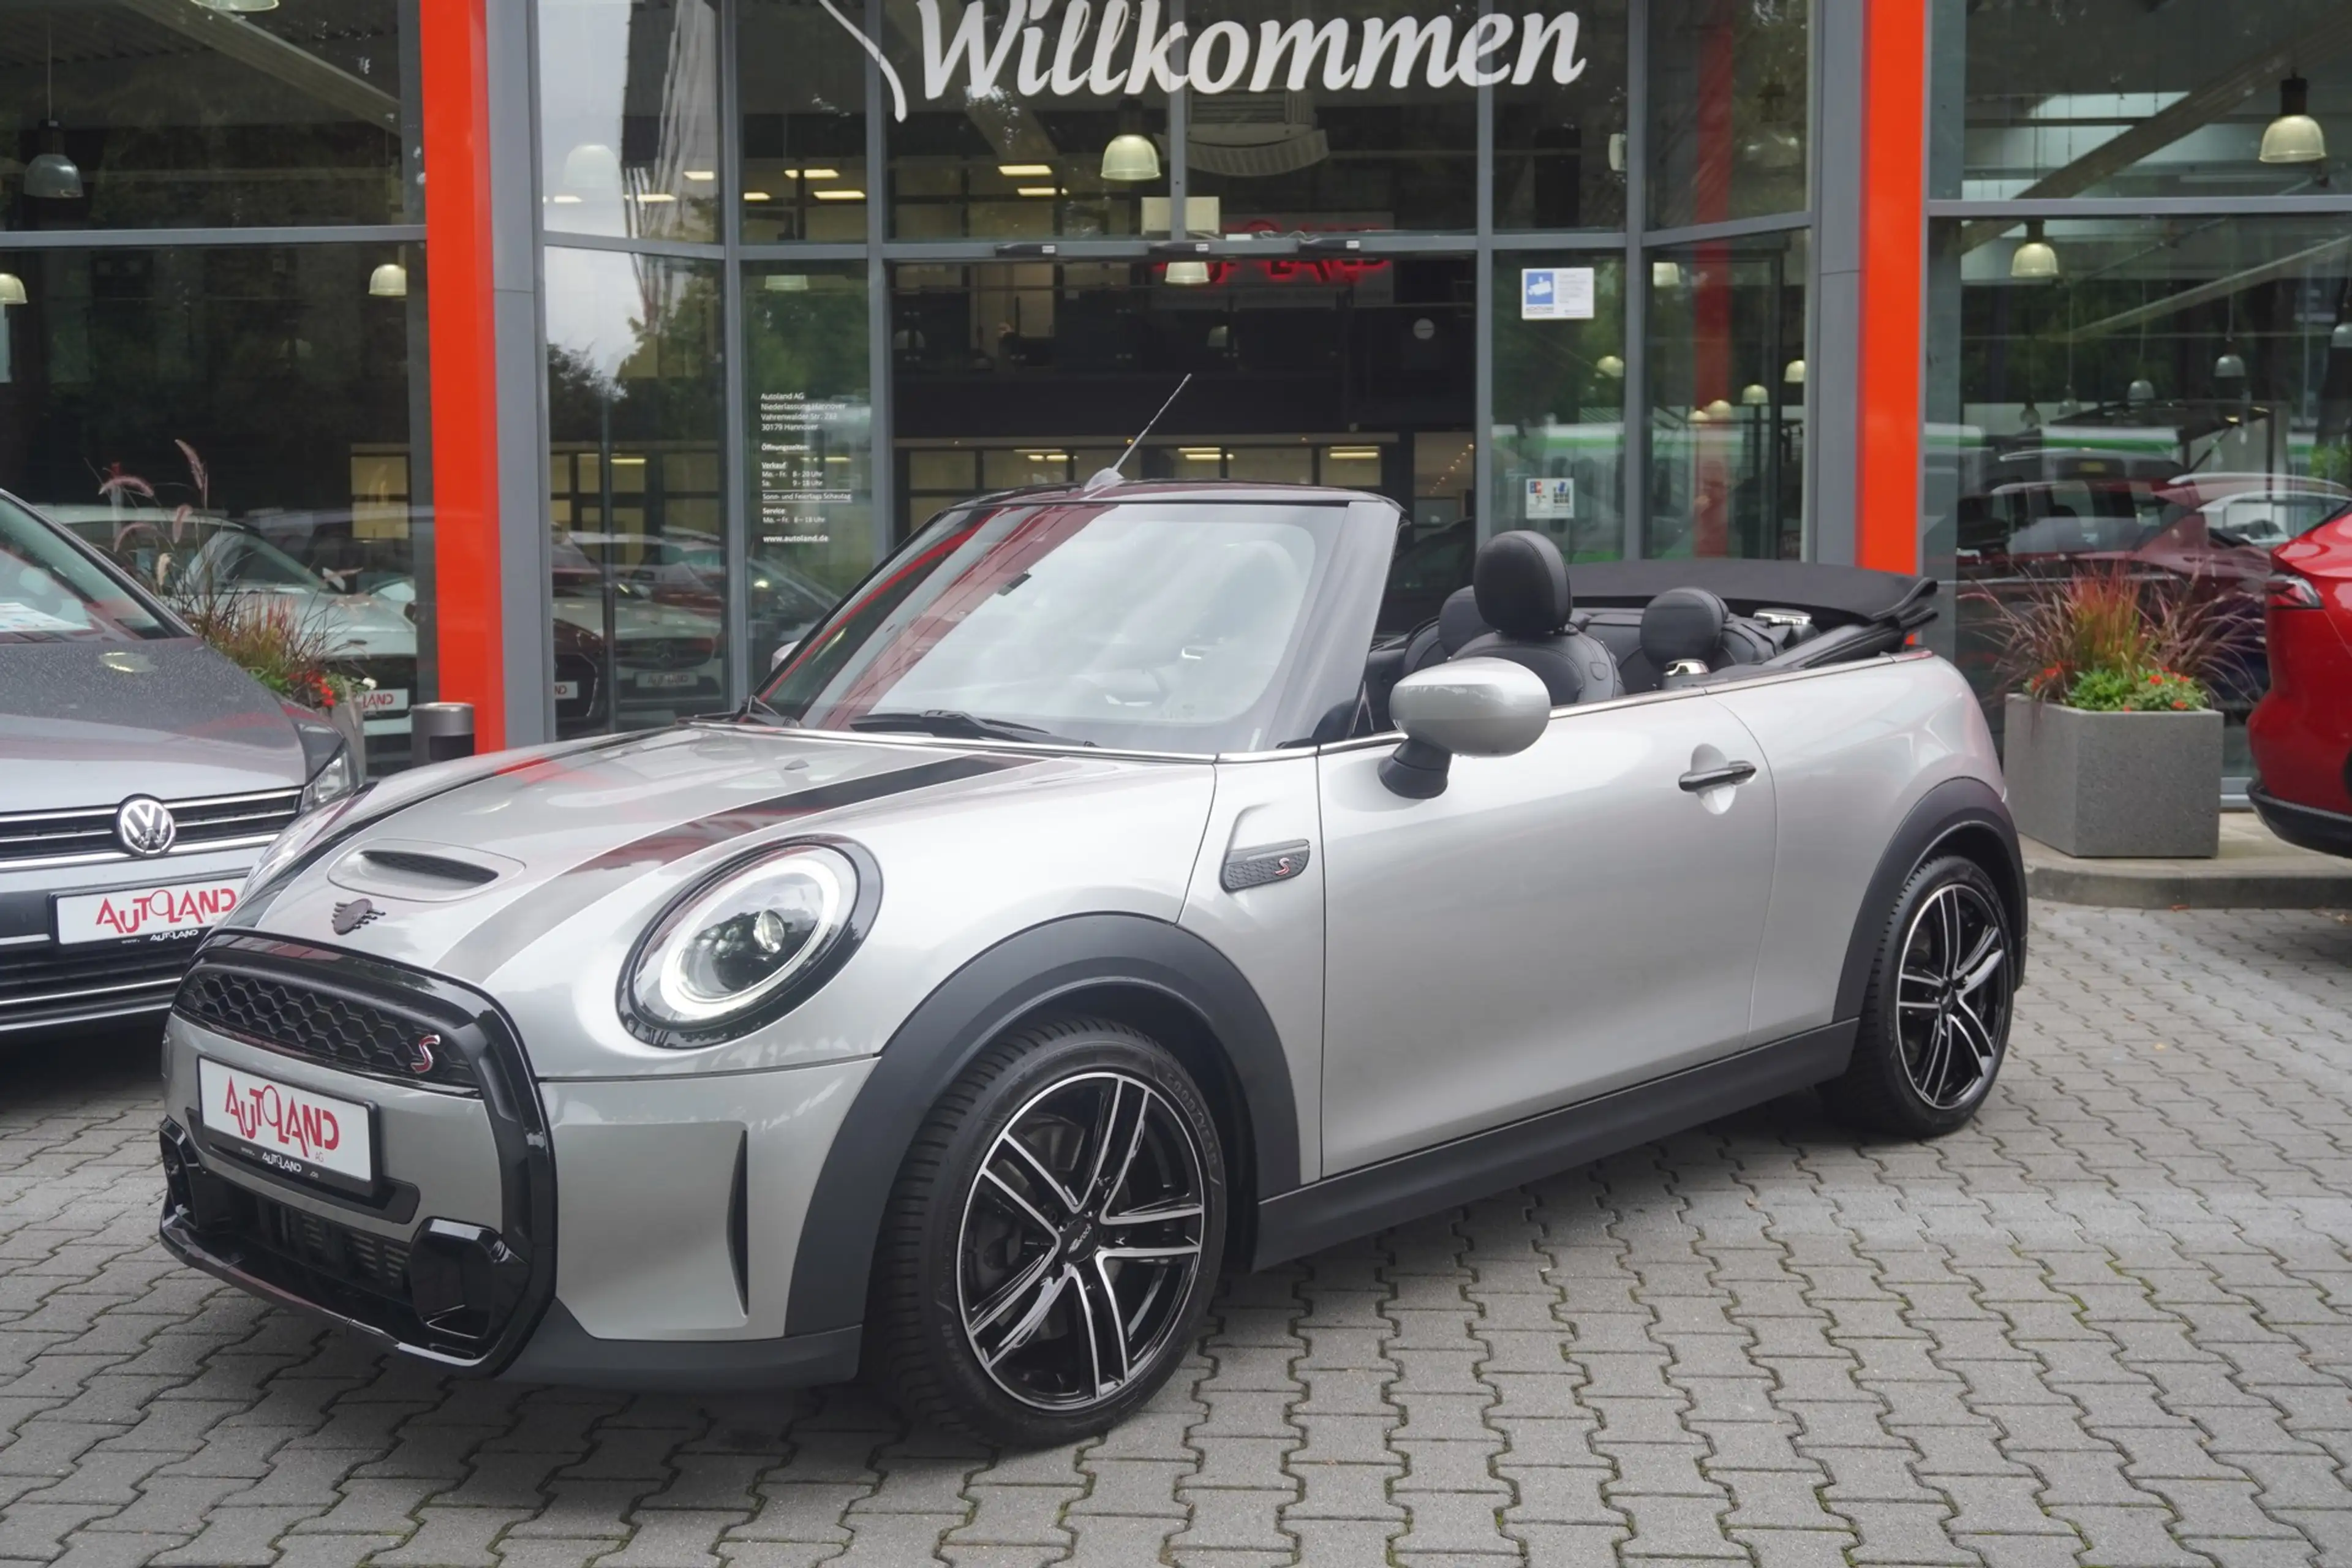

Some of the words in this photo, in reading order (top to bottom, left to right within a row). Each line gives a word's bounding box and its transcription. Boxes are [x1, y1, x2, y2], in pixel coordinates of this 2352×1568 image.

[917, 0, 1587, 99] Willkommen
[763, 534, 828, 543] www.autoland.de
[1274, 858, 1290, 875] S
[96, 888, 236, 933] AUTOLAND
[149, 929, 198, 942] AUTOLAND
[410, 1035, 441, 1073] S
[225, 1075, 339, 1157] AUTOLAND
[262, 1151, 302, 1174] AUTOLAND
